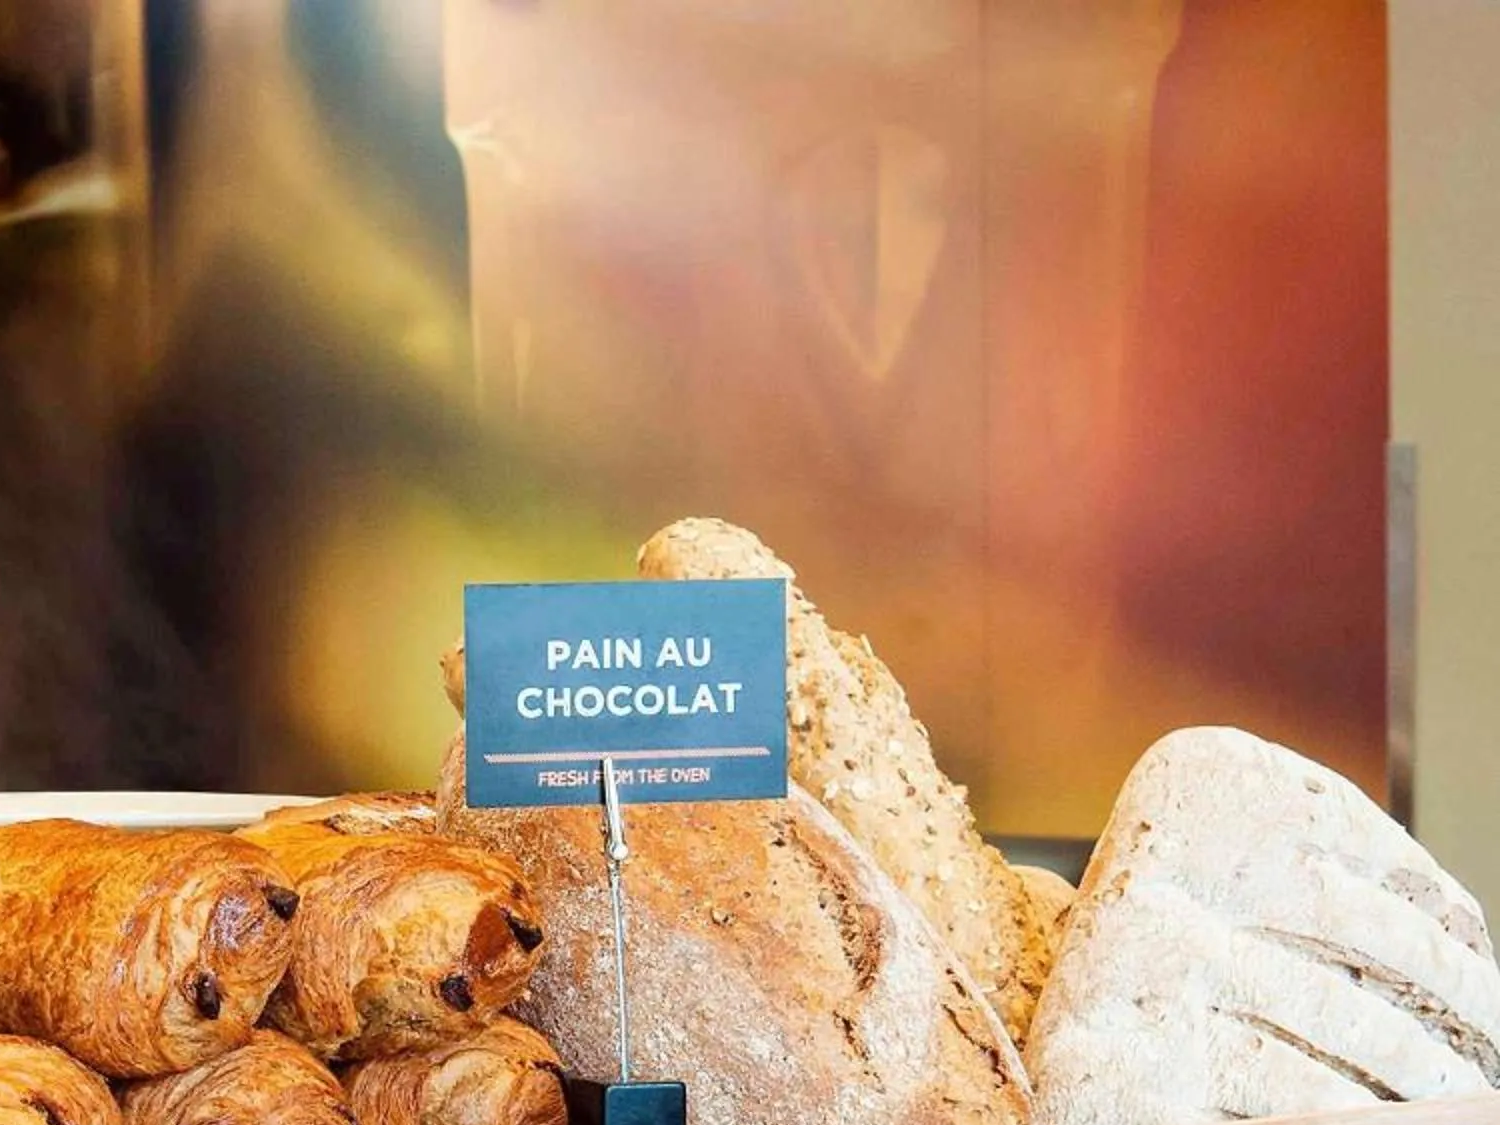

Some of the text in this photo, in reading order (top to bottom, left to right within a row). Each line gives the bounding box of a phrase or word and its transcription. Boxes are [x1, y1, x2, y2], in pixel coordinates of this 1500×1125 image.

[546, 637, 711, 670] PAIN AU
[516, 683, 742, 719] CHOCOLAT
[538, 767, 711, 787] FRESH FOM THE OVEN
